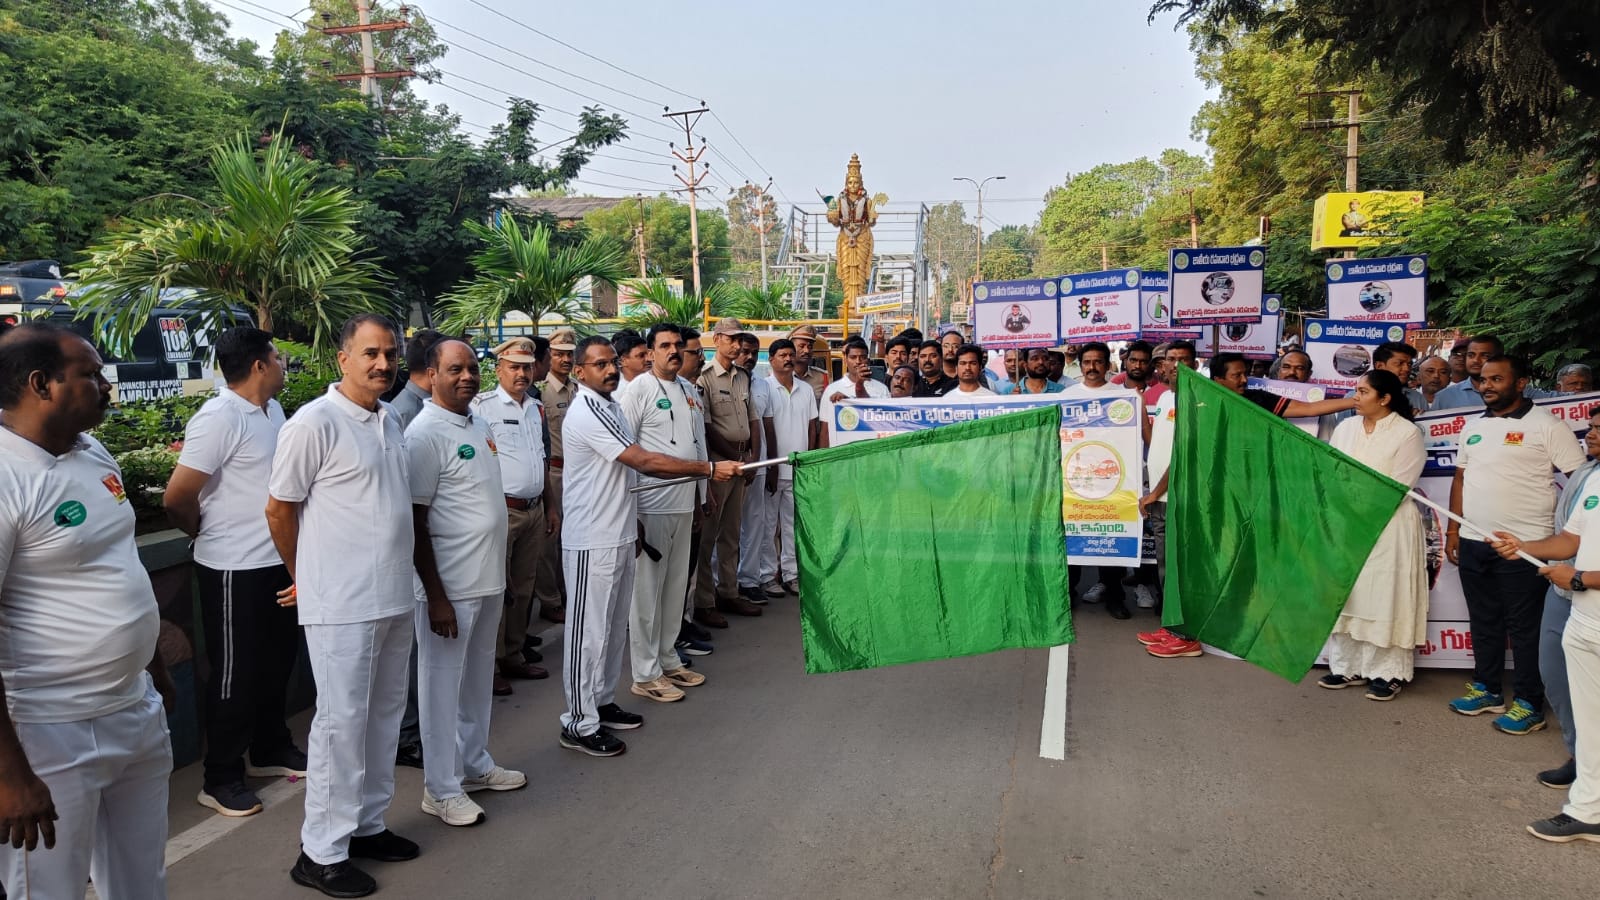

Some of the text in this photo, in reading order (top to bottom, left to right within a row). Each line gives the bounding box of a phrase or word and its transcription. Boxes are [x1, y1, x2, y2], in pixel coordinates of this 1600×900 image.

[163, 330, 190, 352] 108
[119, 379, 182, 390] ADVANCED LIFE SUPPORT
[119, 387, 184, 403] AMBULANCE
[863, 408, 922, 422] రహదారి
[926, 407, 975, 424] భద్రతా
